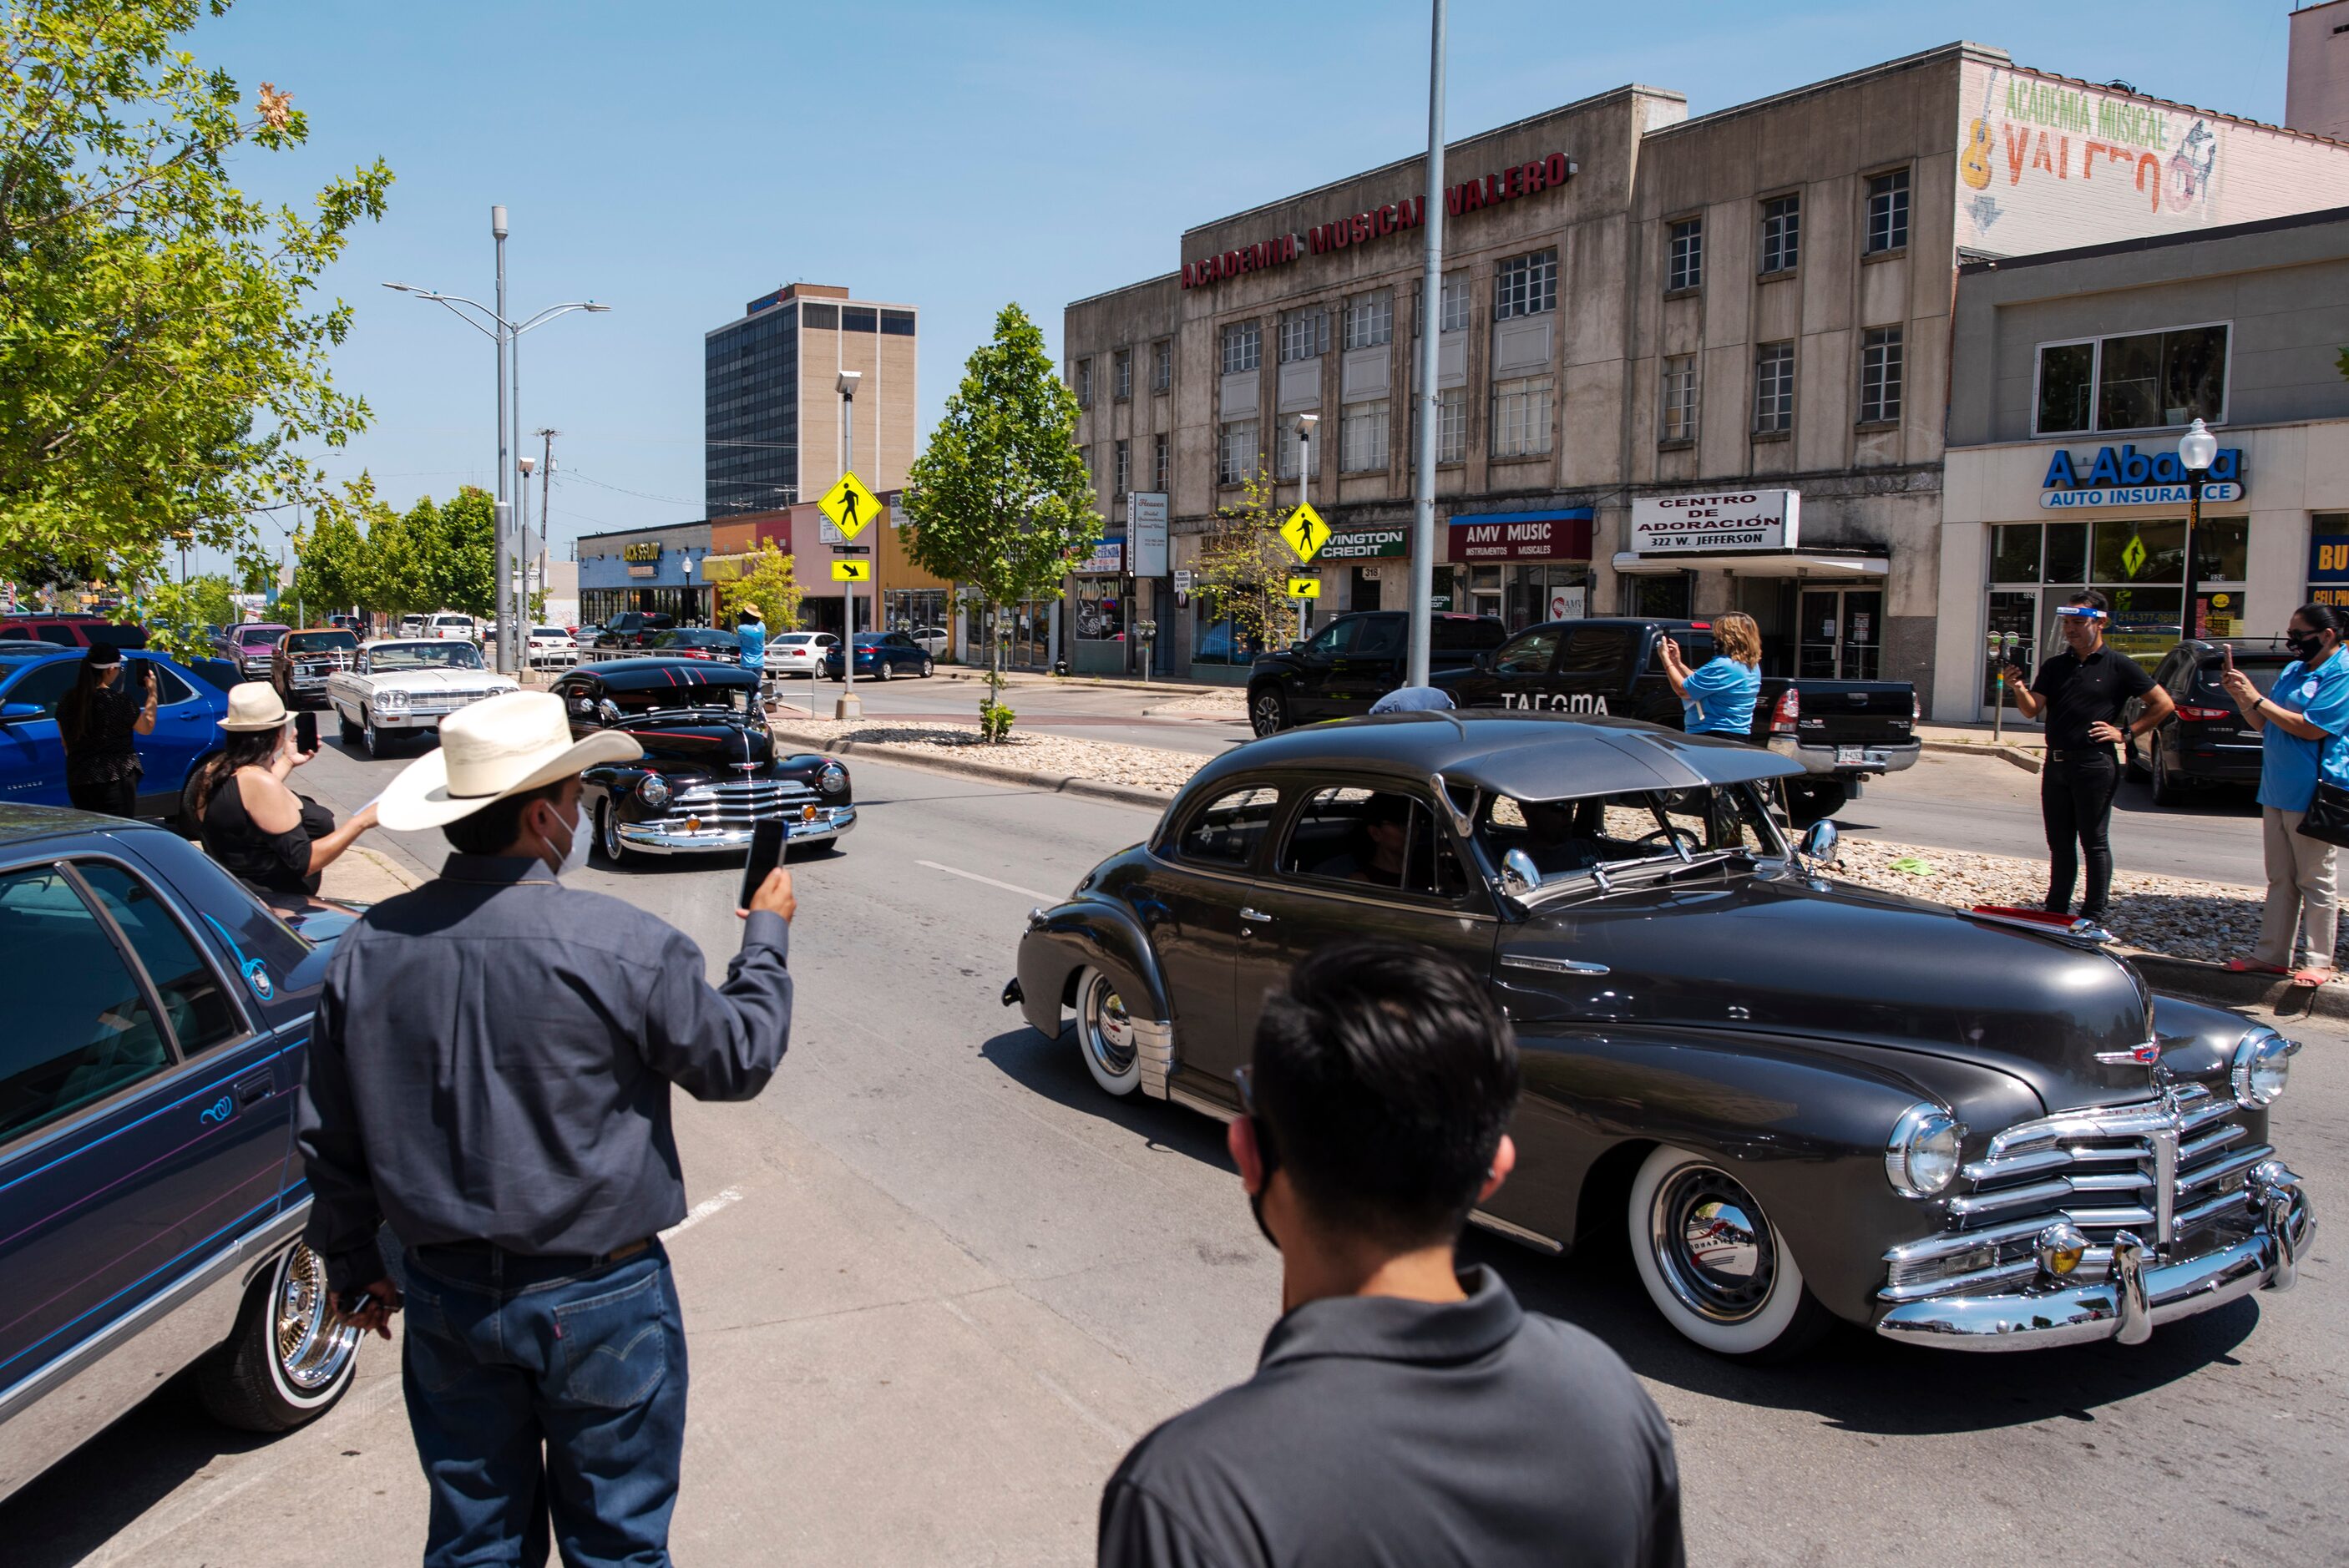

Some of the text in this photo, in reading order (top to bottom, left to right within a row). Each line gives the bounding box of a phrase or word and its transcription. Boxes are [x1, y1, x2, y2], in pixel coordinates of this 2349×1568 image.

[2004, 78, 2167, 151] ACADEMIA MUSICAL
[1181, 232, 1299, 291] ACADEMIA
[1445, 152, 1570, 218] VALERO
[2043, 449, 2078, 488] A
[1658, 494, 1758, 508] CENTRO
[2048, 490, 2103, 506] AUTO
[1688, 508, 1719, 518] DE
[1638, 513, 1780, 532] ADORACIÓN
[1322, 531, 1403, 546] VINGTON
[1466, 523, 1552, 543] AMV MUSIC
[1651, 534, 1763, 547] 322 W. JEFFERSON
[1321, 545, 1383, 558] CREDIT
[1466, 544, 1552, 556] INSTRUMENTOS MUSICALES
[2318, 544, 2349, 571] BU
[1364, 569, 1379, 577] 318
